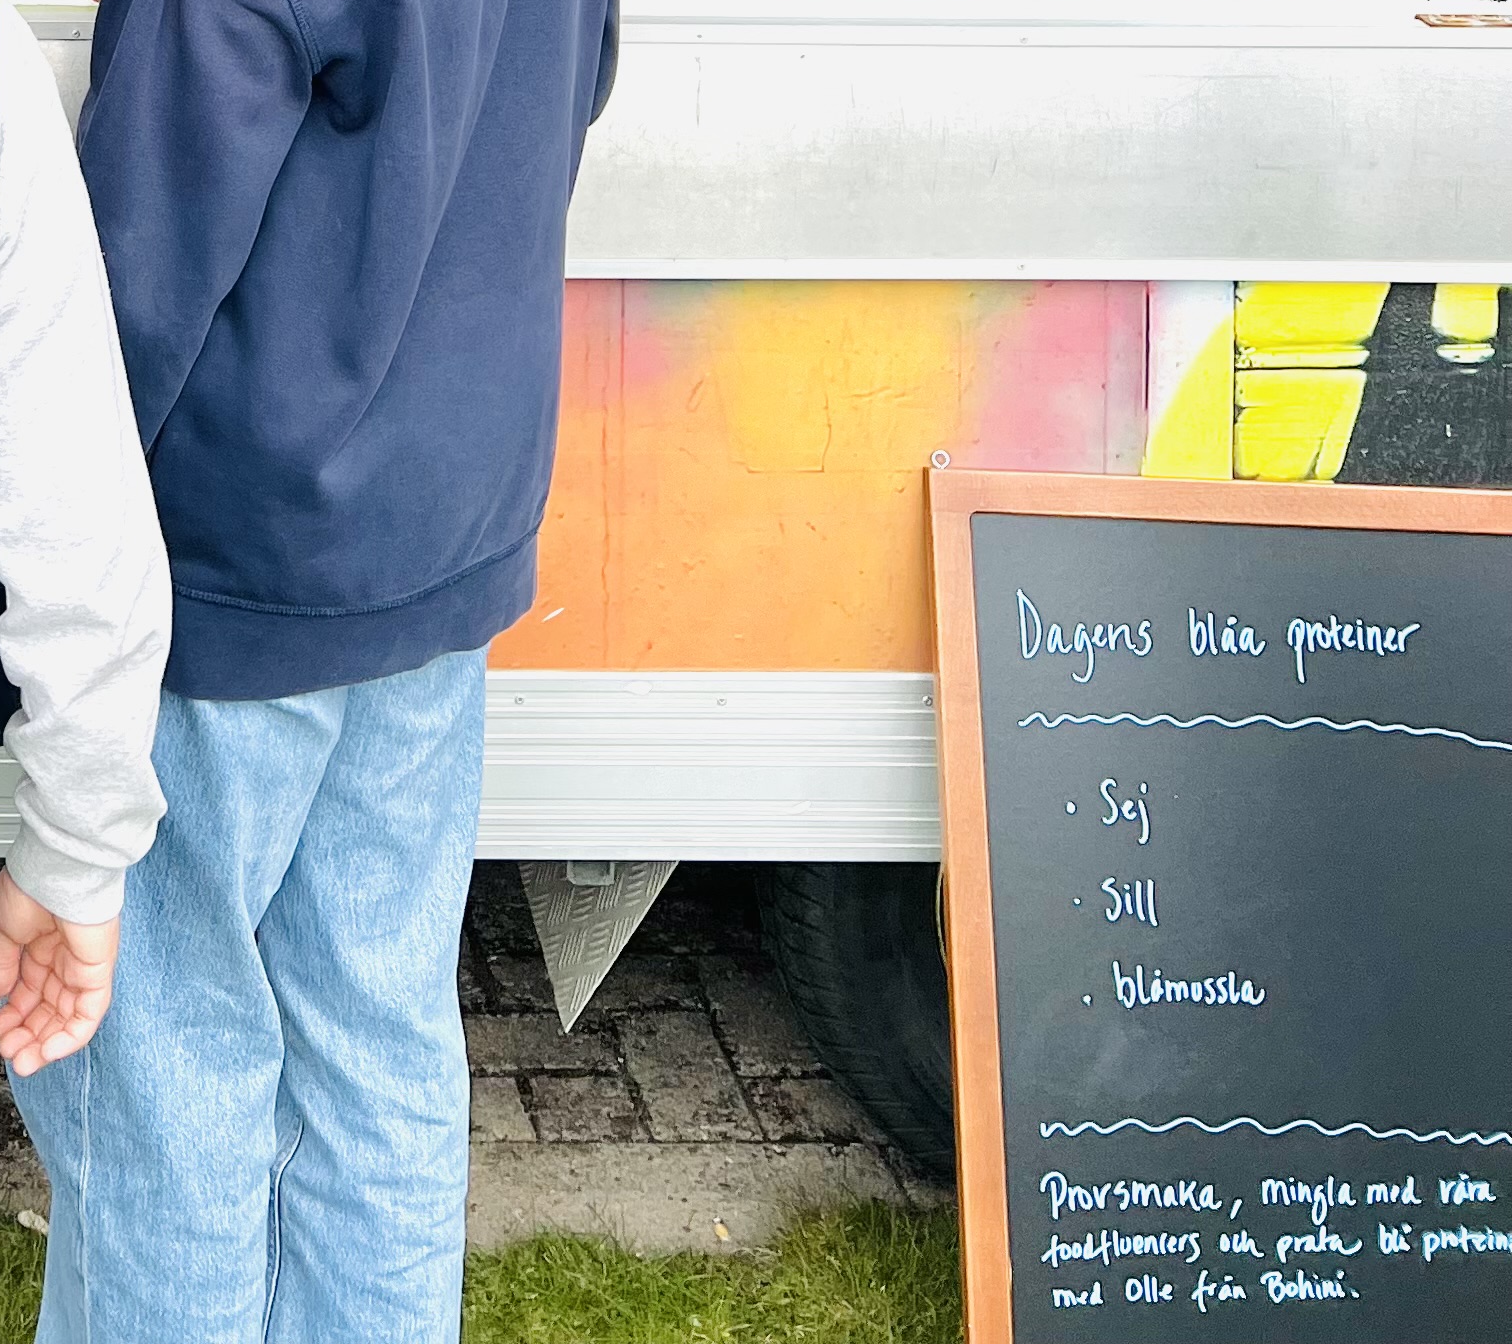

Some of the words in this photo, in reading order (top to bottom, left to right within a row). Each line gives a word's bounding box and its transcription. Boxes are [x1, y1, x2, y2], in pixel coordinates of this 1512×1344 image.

[1015, 587, 1153, 684] Dagens
[1188, 607, 1266, 657] blåa
[1287, 614, 1421, 684] proteiner
[1099, 777, 1150, 845] Sej
[1101, 876, 1158, 927] Sill
[1112, 960, 1266, 1009] blåmussla
[1366, 1175, 1423, 1205] med
[1438, 1172, 1497, 1205] våra
[1040, 1229, 1201, 1268] foodfluencers
[1219, 1229, 1265, 1258] och
[1276, 1225, 1363, 1264] prata
[1052, 1281, 1104, 1308] med
[1125, 1274, 1174, 1303] Olle
[1191, 1269, 1247, 1313] från
